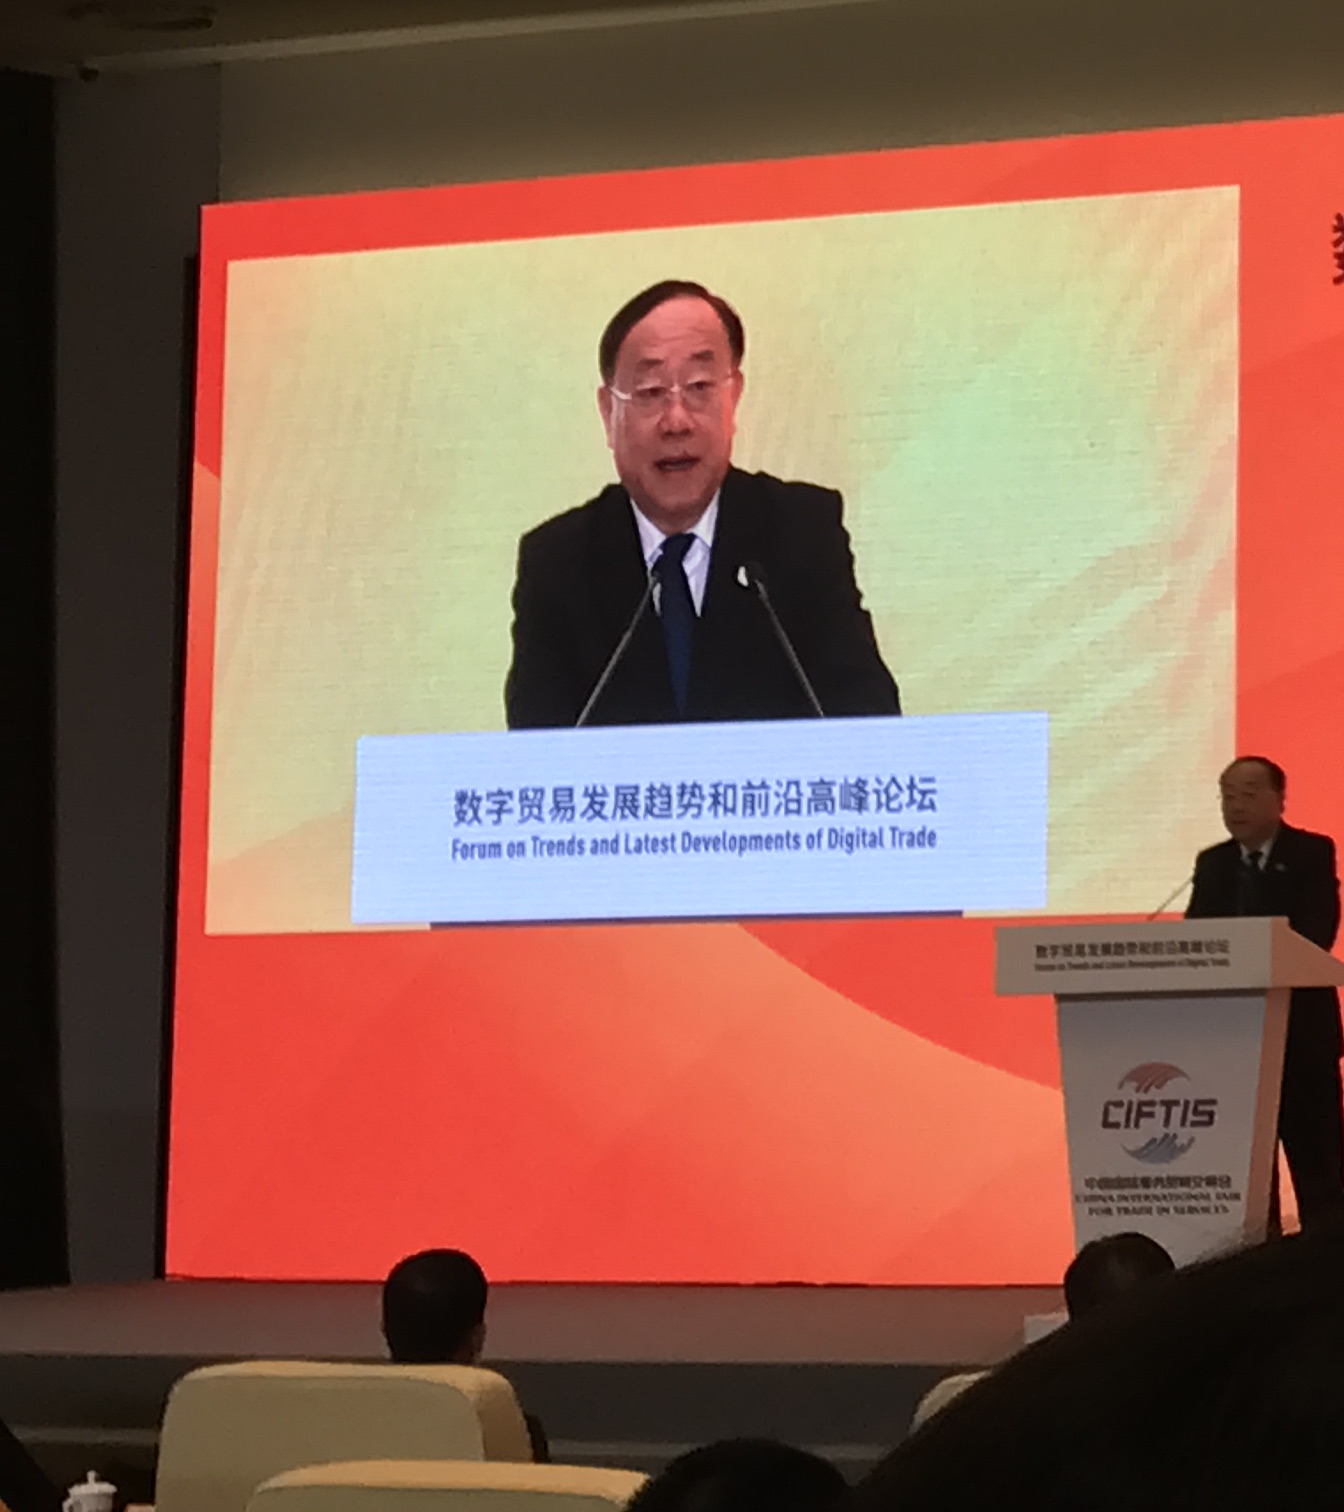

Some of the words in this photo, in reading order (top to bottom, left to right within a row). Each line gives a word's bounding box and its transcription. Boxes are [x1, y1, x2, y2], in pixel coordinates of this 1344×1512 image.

[453, 775, 937, 827] 数字贸易发展趋势和前沿高峰论坛
[452, 838, 502, 861] Forum
[507, 841, 526, 859] on
[531, 835, 585, 858] Trends
[590, 833, 619, 856] and
[625, 831, 676, 855] Latest
[681, 828, 801, 857] Developments
[806, 827, 823, 851] of
[828, 826, 884, 855] Digital
[889, 825, 937, 849] Trade
[1101, 1098, 1218, 1129] CIFTIS
